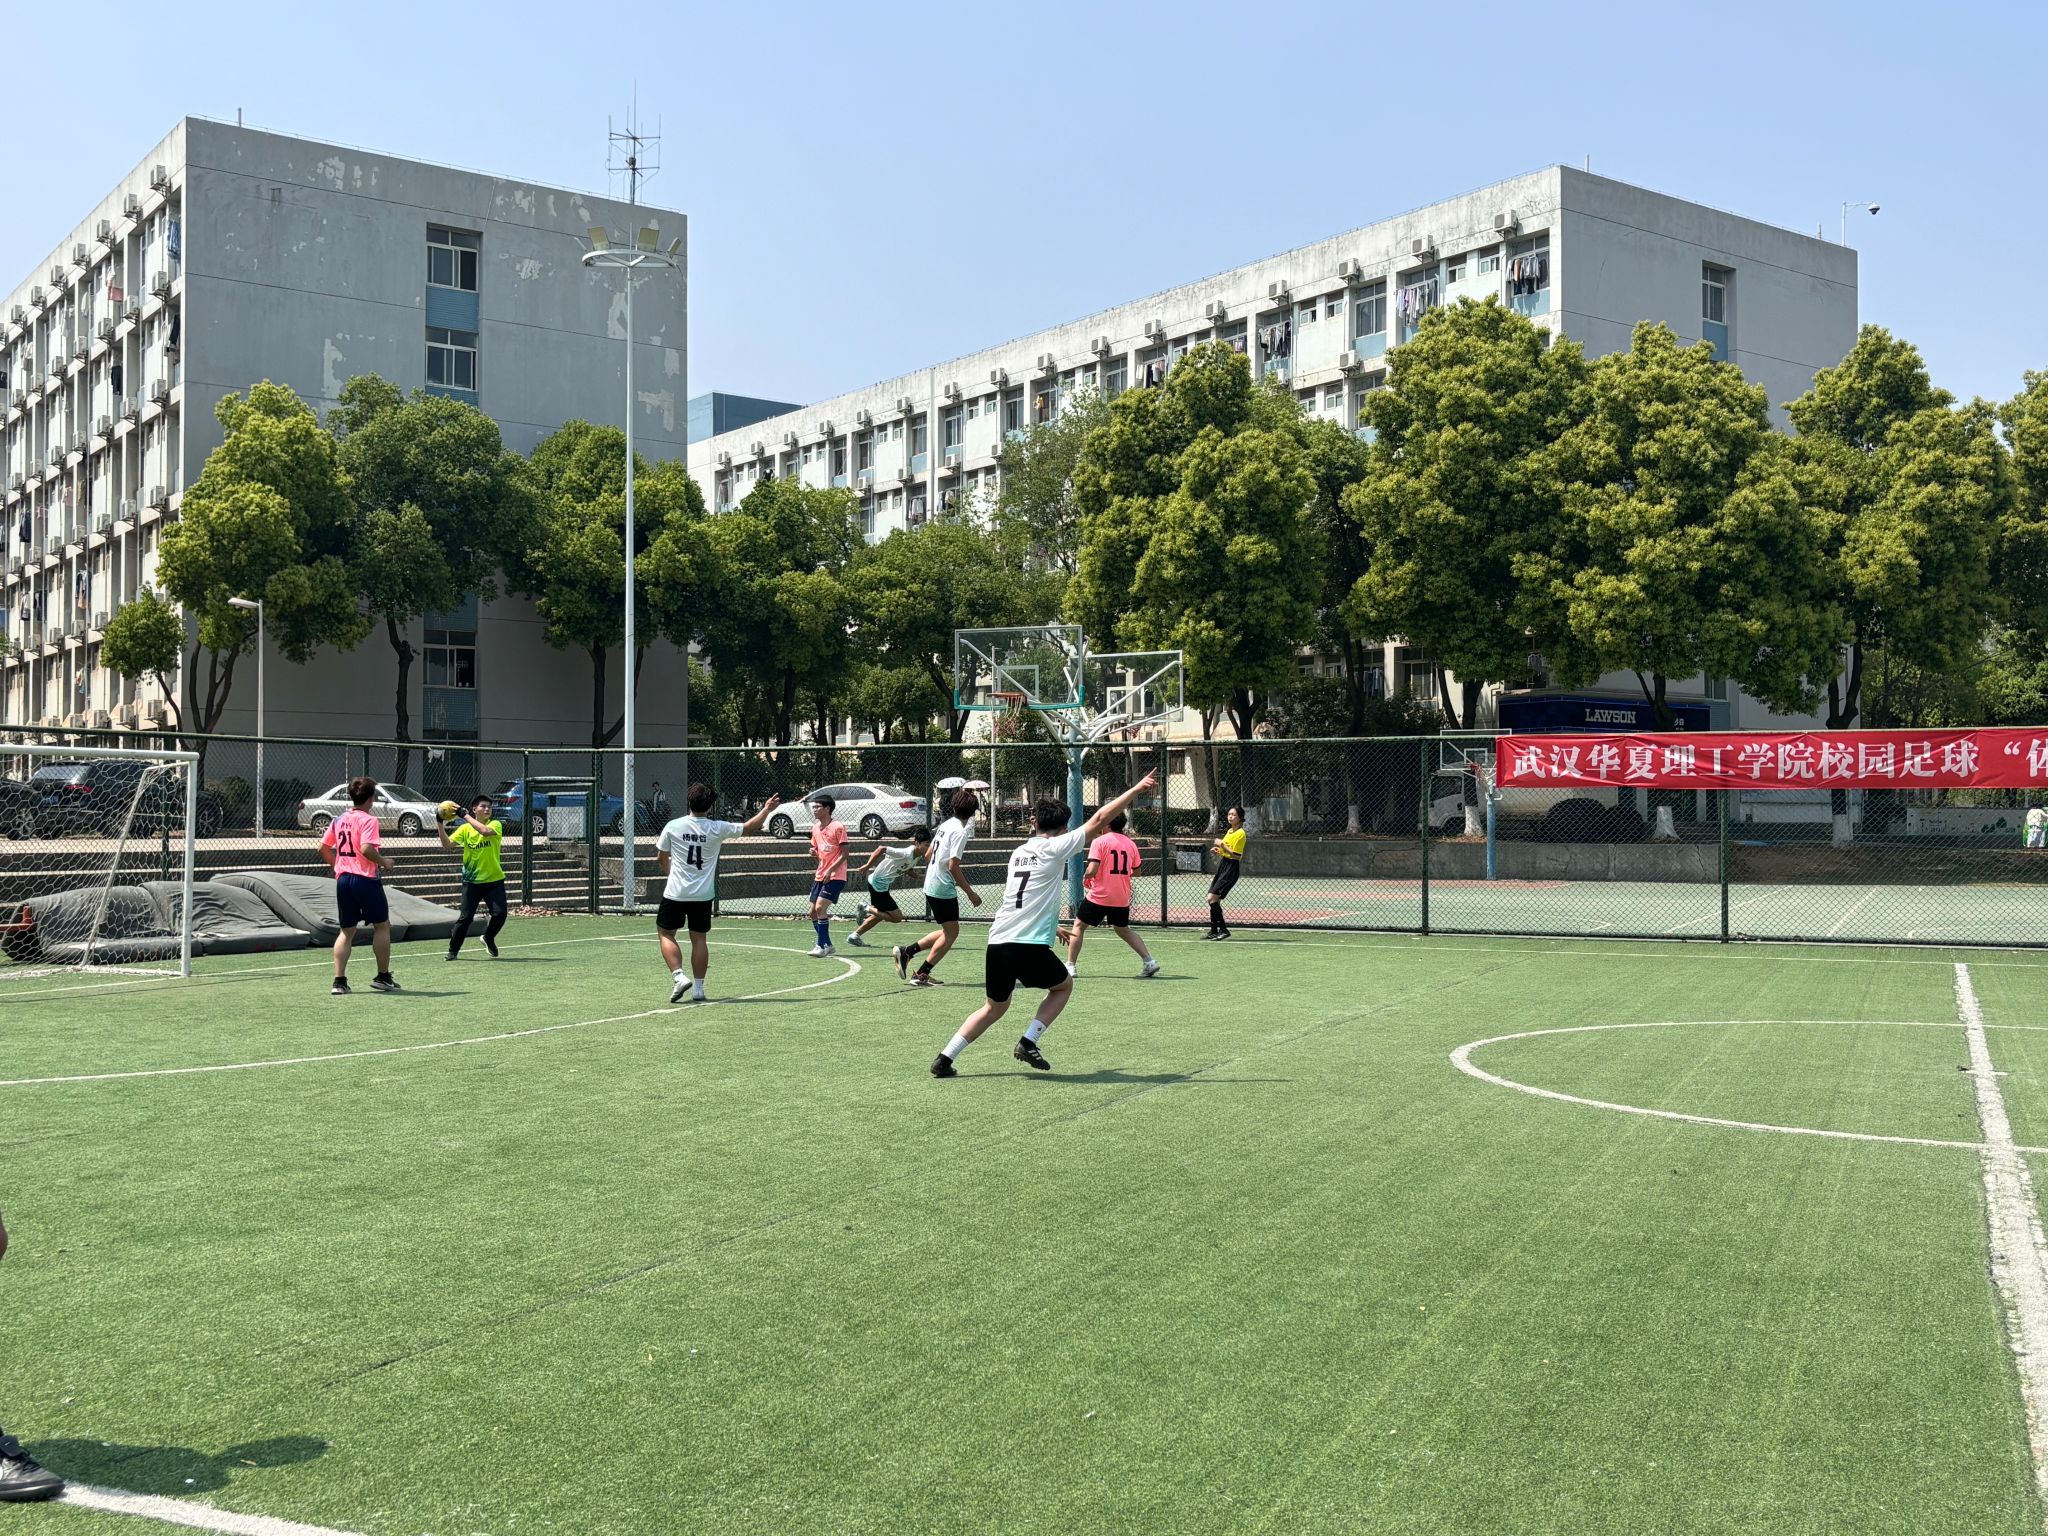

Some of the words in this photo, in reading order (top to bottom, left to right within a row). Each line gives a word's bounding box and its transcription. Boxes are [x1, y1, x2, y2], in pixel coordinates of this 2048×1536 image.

[1585, 709, 1636, 724] LAWSON
[338, 831, 357, 857] 21
[687, 845, 703, 870] 4
[1109, 849, 1129, 875] 11
[1013, 870, 1031, 909] 7
